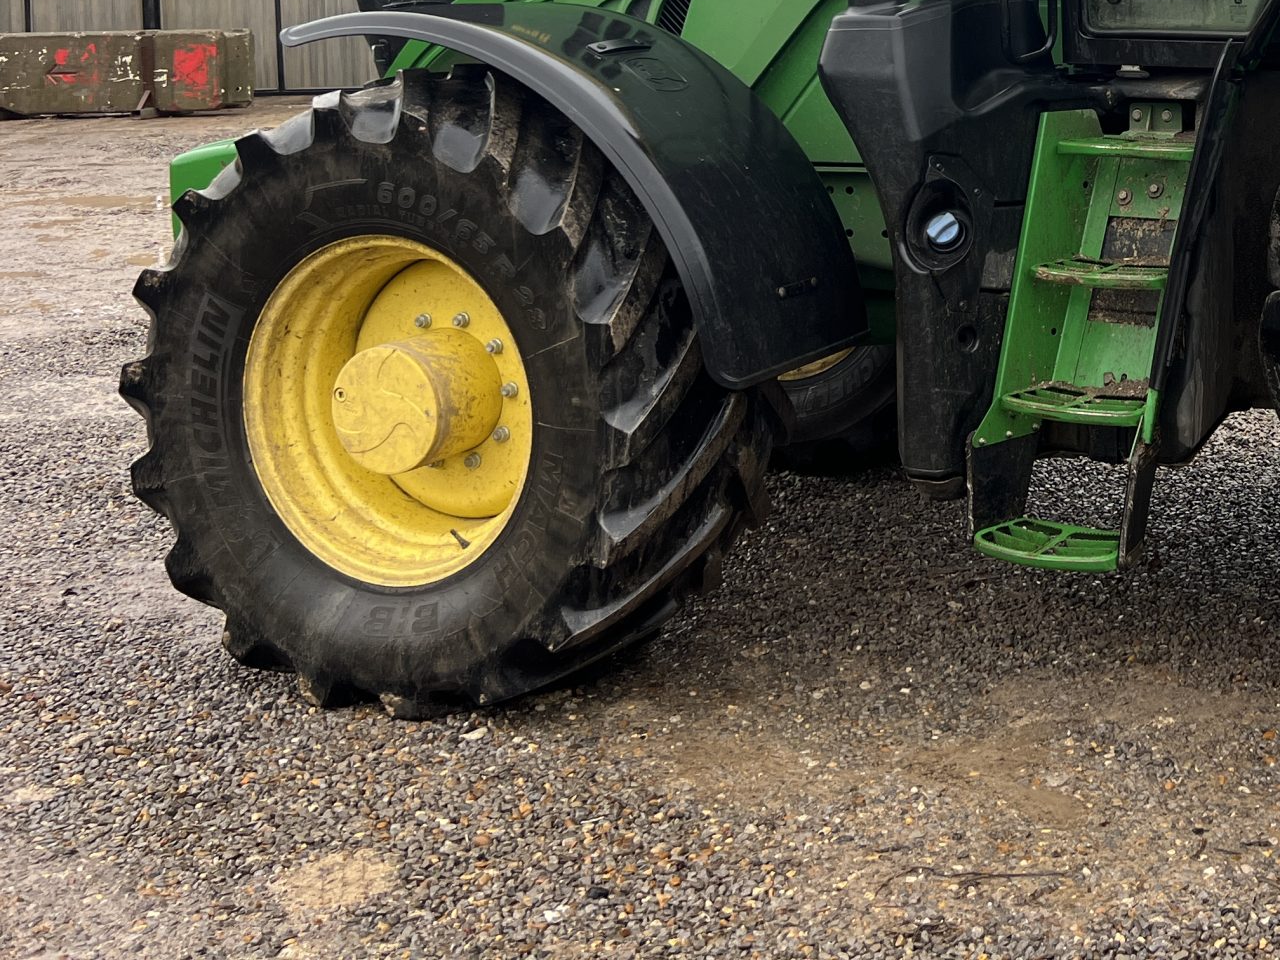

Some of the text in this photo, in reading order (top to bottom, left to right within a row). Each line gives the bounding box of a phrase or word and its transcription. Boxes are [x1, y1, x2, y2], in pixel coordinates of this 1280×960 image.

[377, 181, 497, 255] 600/65
[191, 297, 245, 510] MICHELIN
[363, 602, 441, 638] BIB
